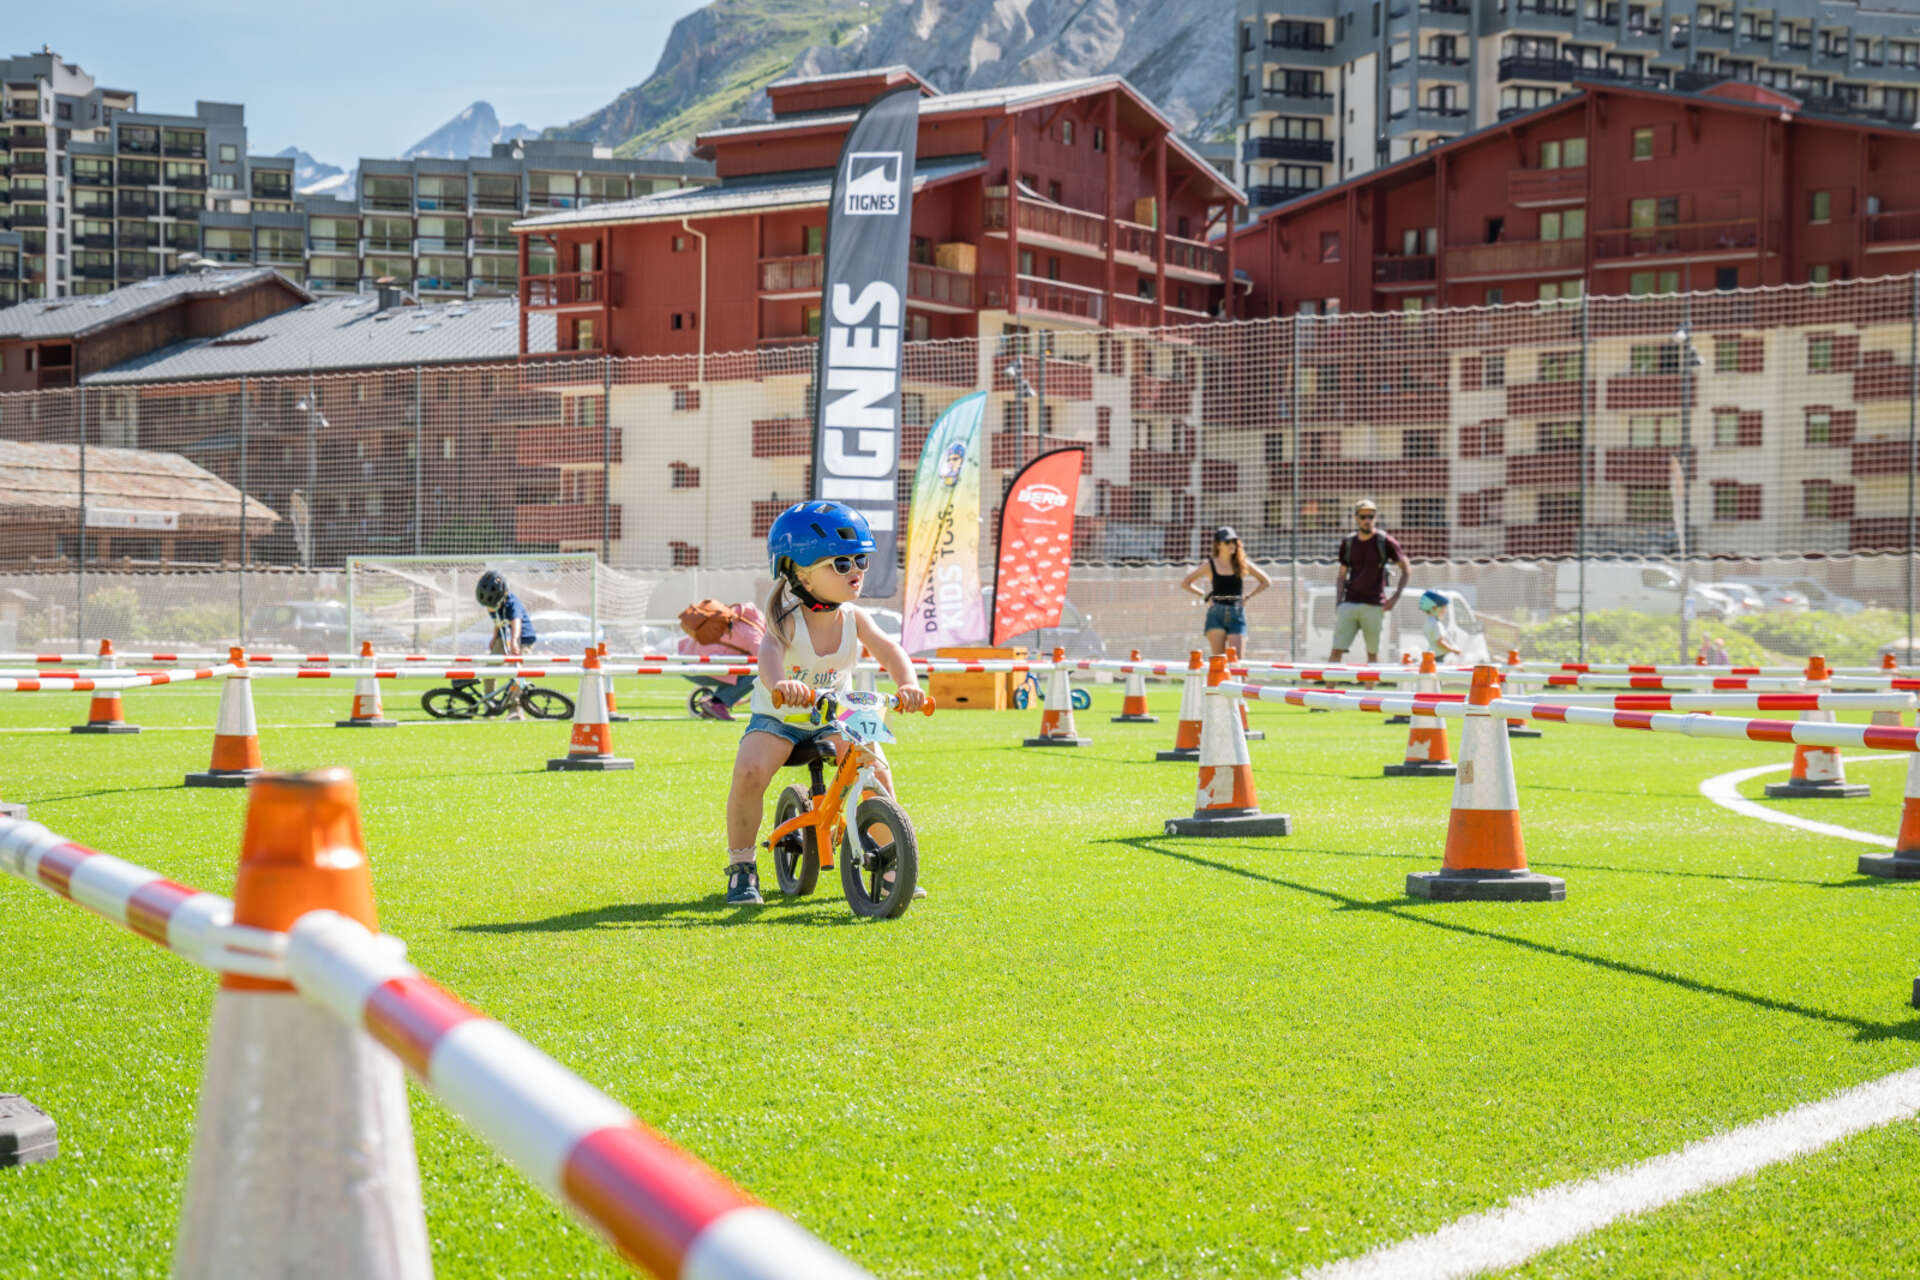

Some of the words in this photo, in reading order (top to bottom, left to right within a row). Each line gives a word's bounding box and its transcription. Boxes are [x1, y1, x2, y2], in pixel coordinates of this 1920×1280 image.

[849, 194, 896, 211] TIGNES
[938, 564, 964, 629] KIDS
[860, 721, 877, 735] 17
